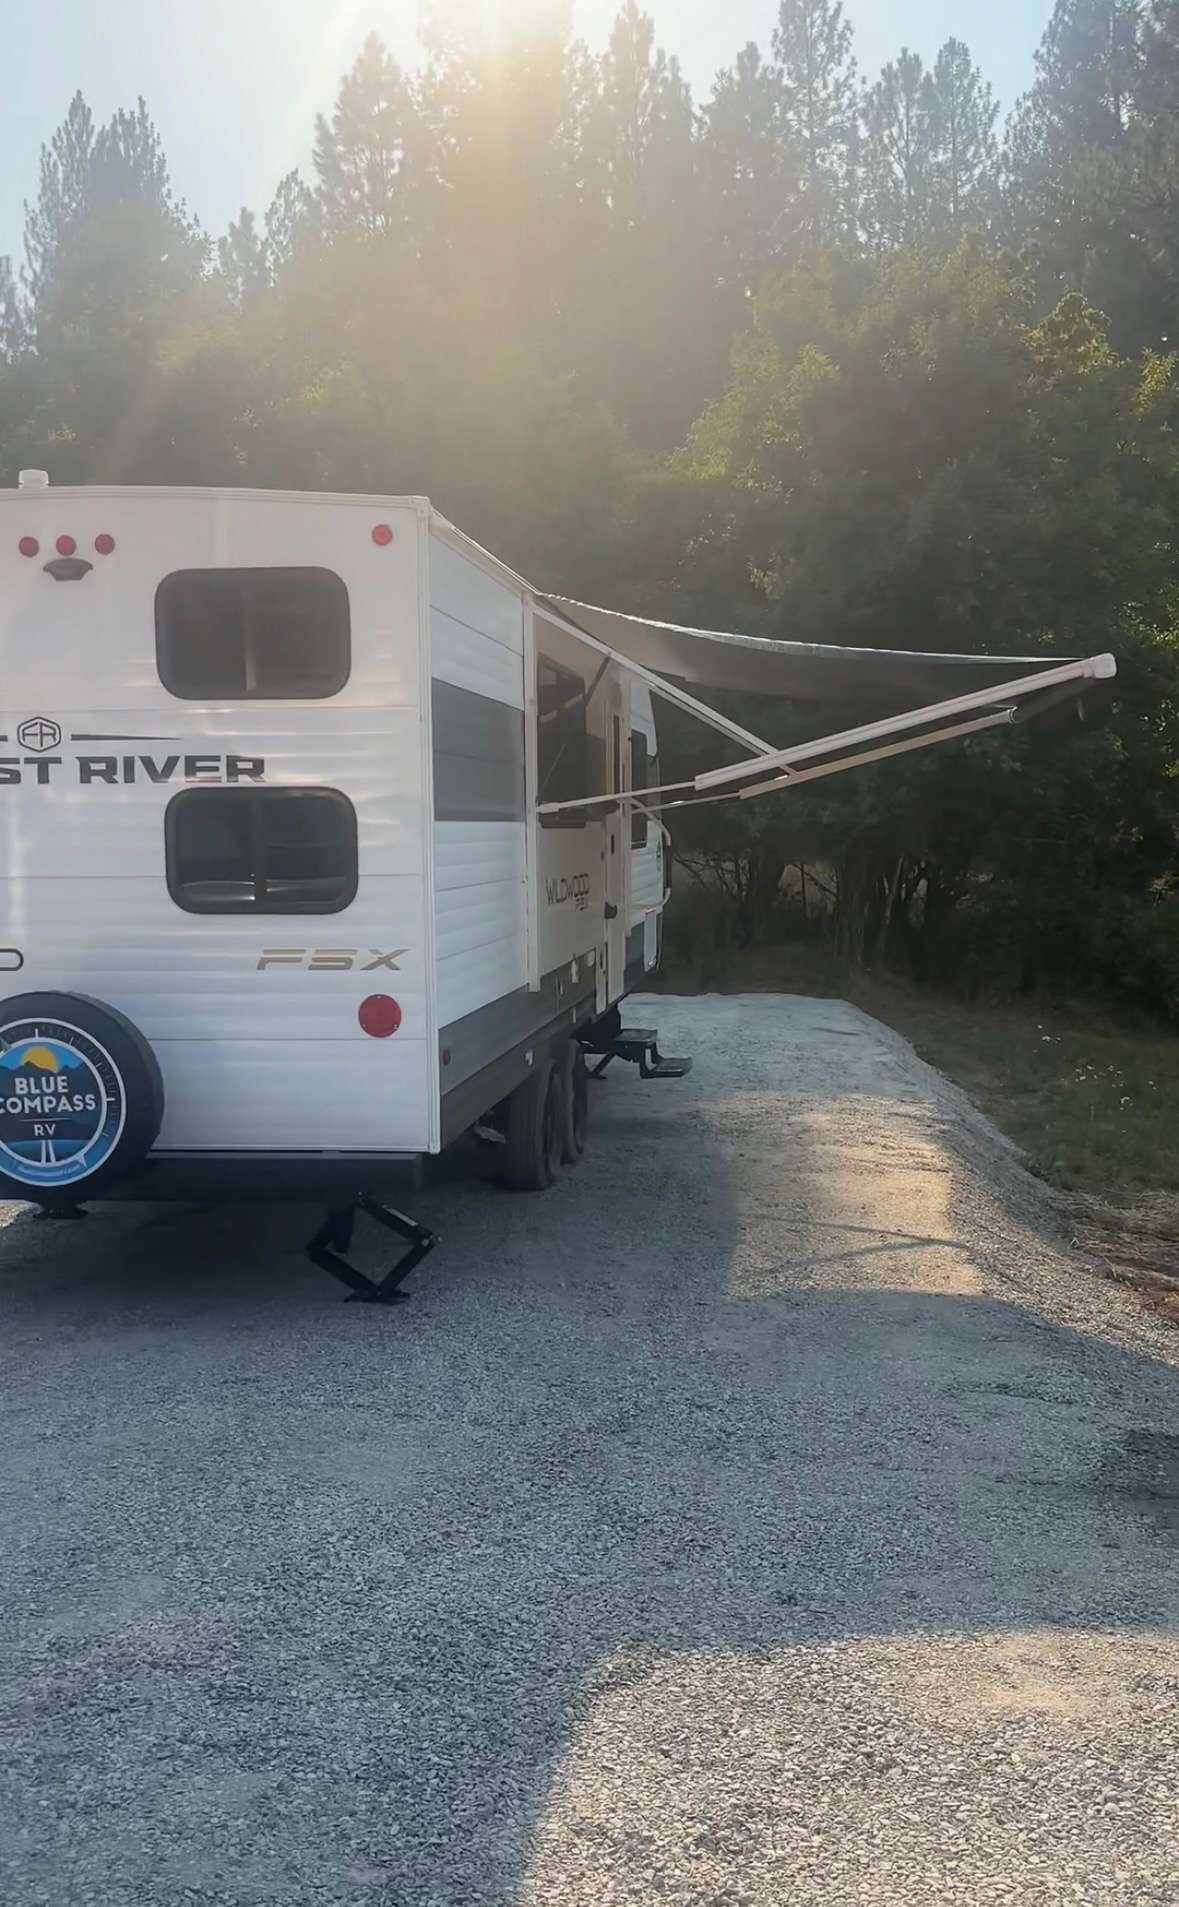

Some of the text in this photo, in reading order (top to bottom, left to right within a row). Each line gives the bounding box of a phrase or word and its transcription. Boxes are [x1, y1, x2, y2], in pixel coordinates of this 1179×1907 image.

[75, 755, 265, 784] RIVER
[256, 949, 409, 970] FSX
[15, 1076, 68, 1095] BLUE
[0, 1094, 96, 1114] OMPASS
[34, 1123, 56, 1137] RV
